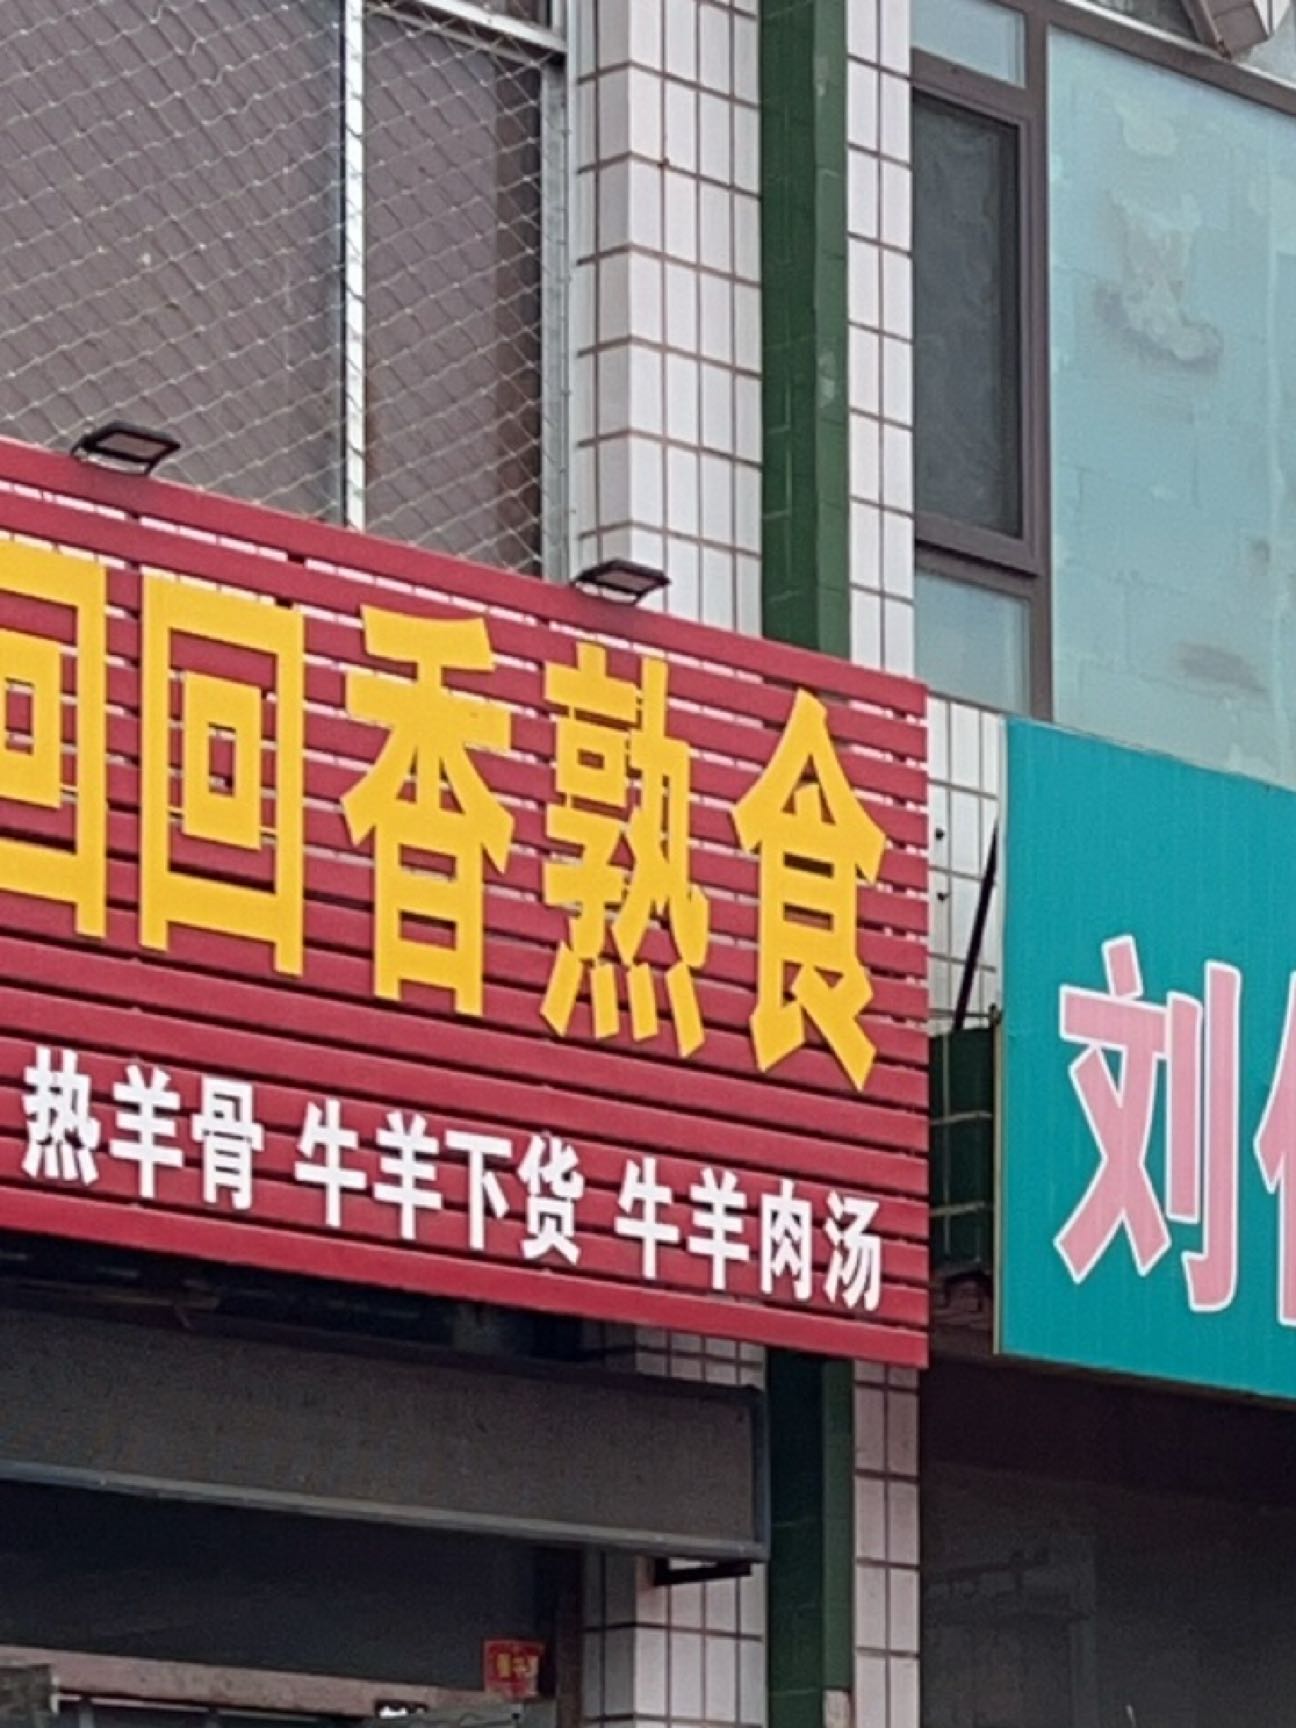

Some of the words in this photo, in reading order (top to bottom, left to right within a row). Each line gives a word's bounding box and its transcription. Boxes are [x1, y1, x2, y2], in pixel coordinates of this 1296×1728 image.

[0, 539, 886, 1091] 回回香熟食
[22, 1045, 264, 1211] 热羊骨
[294, 1098, 585, 1266] 牛羊下货
[614, 1157, 883, 1312] 牛羊肉汤
